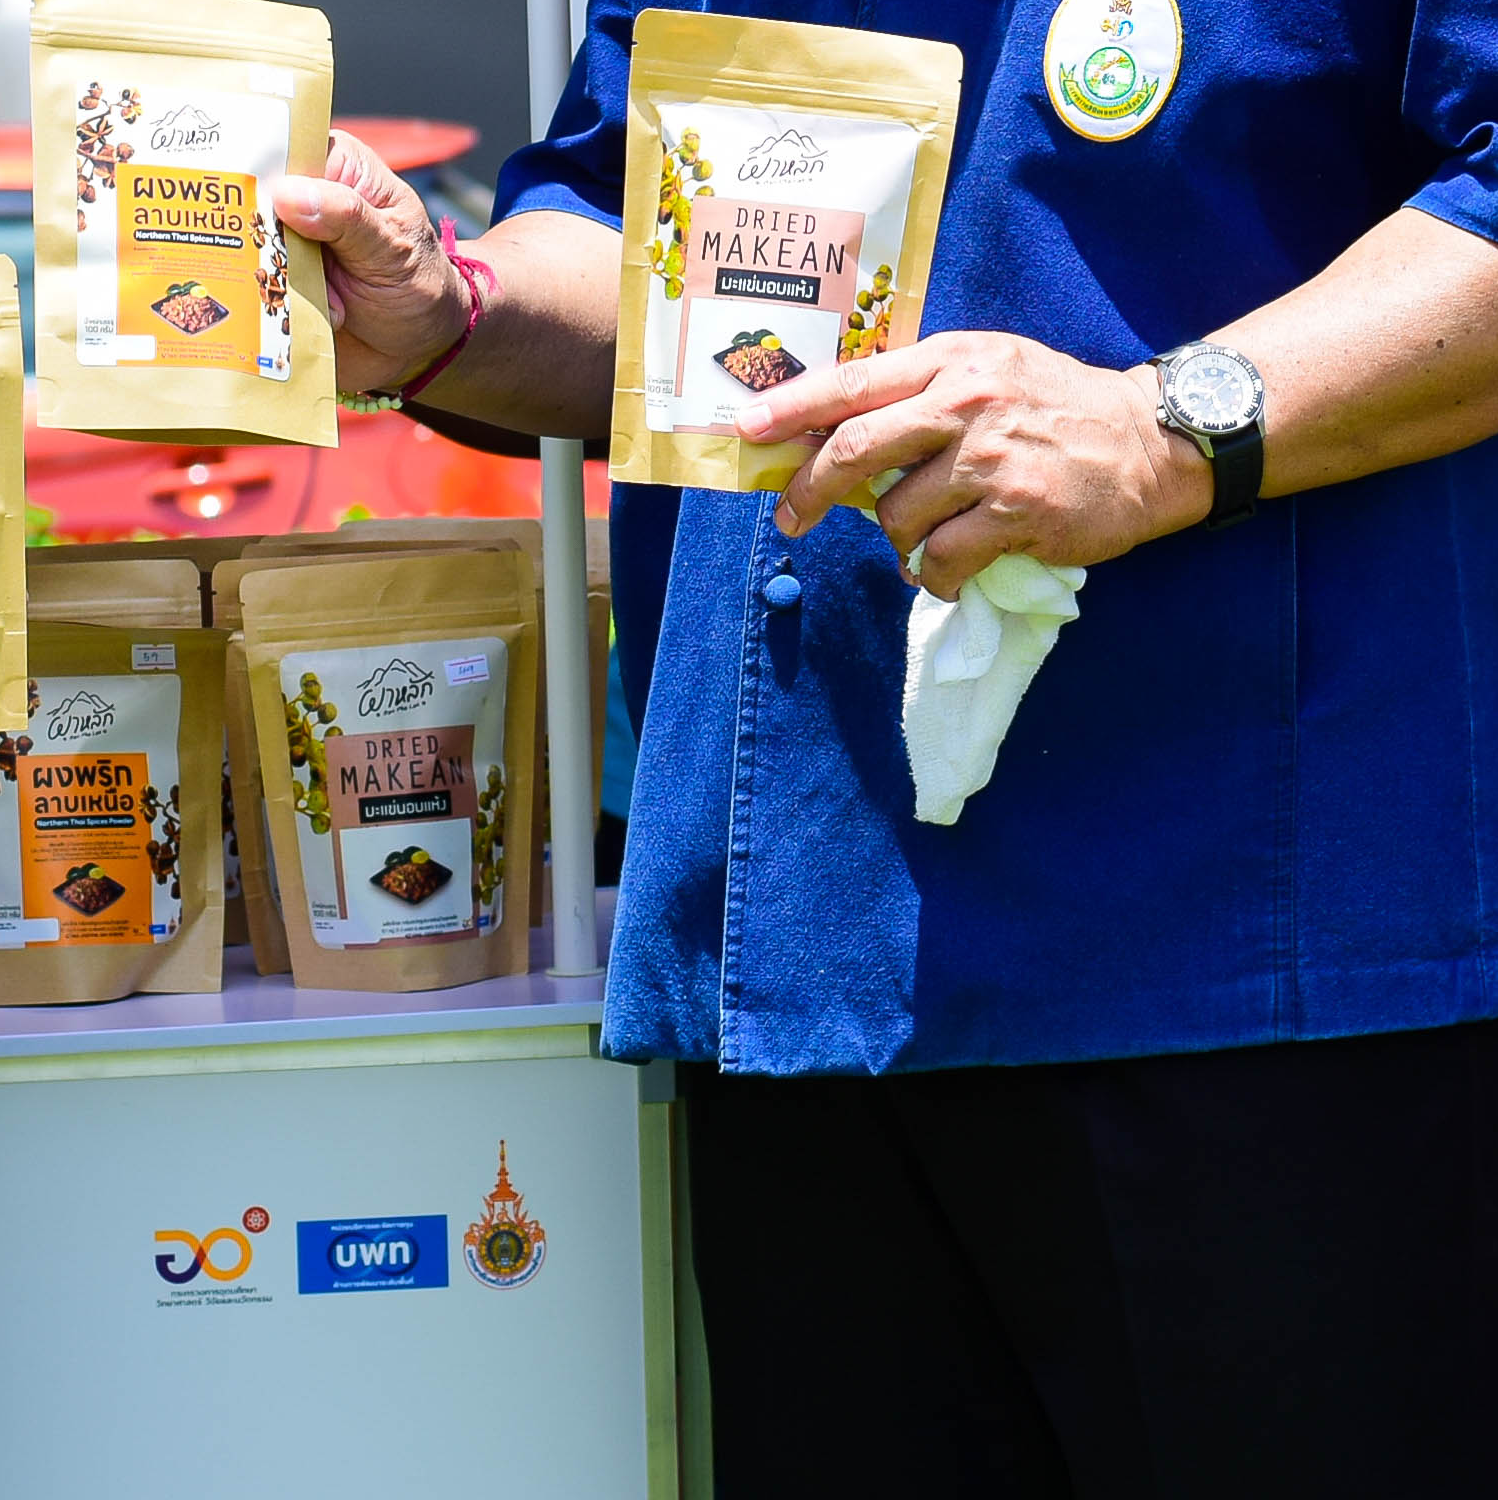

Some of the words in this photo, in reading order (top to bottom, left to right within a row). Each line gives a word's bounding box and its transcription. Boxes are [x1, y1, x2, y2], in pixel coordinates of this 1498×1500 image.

[150, 122, 220, 150] ผาหลัก
[738, 150, 828, 181] ผาหลัก
[133, 175, 243, 206] ผงพริก
[134, 205, 243, 232] ลาบเหนือ
[735, 207, 817, 235] DRIED
[135, 231, 171, 241] Northern
[171, 232, 189, 242] Thai
[189, 234, 214, 245] Spices
[214, 237, 242, 247] Powder
[701, 230, 845, 275] MAKEAN
[721, 274, 814, 299] มะแข่นอบแห้ง
[358, 670, 434, 717] ผาหลัก
[47, 703, 114, 740] ผาหลัก
[365, 735, 439, 760] DRIED
[33, 758, 133, 789] ผงพริก
[340, 756, 464, 795] MAKEAN
[34, 787, 134, 814] ลาบเหนือ
[365, 796, 447, 818] มะแข่นอบแห้ง
[36, 819, 70, 827] Northern
